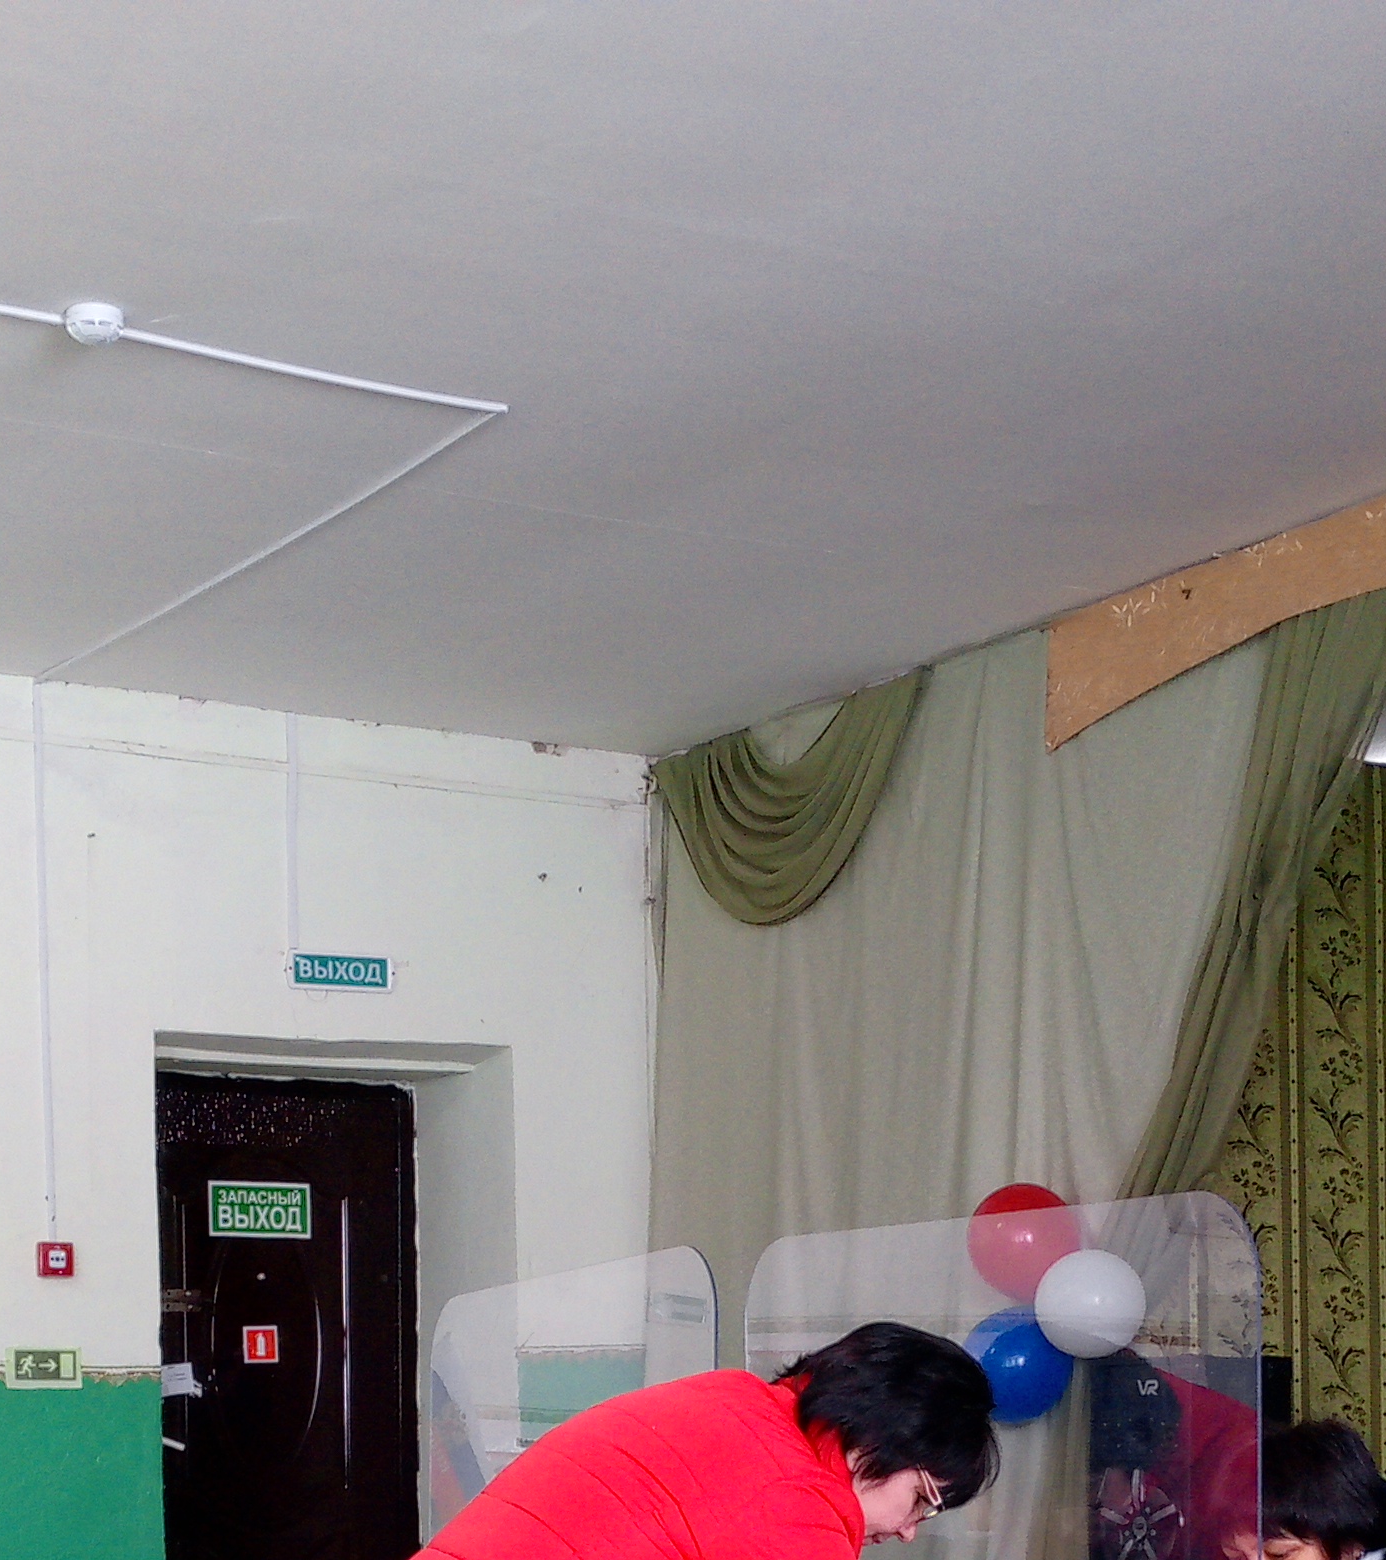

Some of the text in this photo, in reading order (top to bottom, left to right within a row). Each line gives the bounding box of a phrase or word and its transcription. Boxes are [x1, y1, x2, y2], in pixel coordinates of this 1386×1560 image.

[298, 959, 382, 984] ВЫХОД
[218, 1189, 301, 1205] ЗАПАСНЫЙ
[218, 1205, 302, 1232] ВЫХОД
[1136, 1379, 1159, 1396] VR
